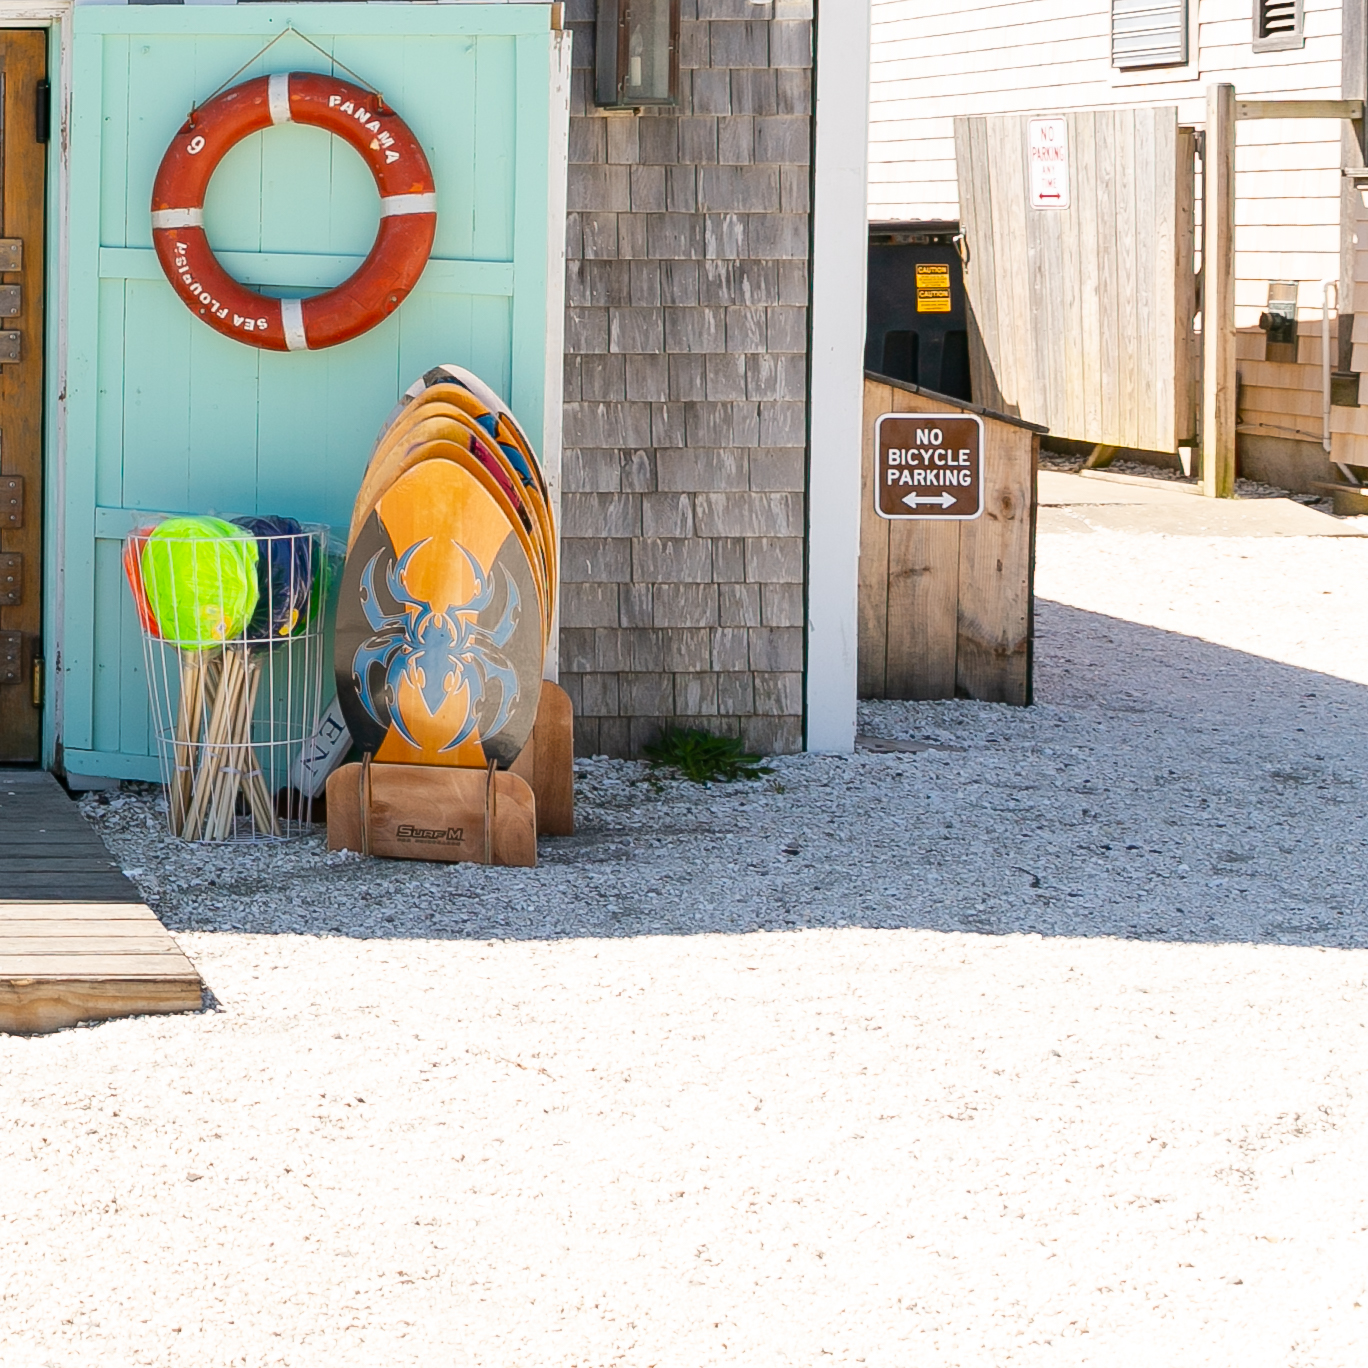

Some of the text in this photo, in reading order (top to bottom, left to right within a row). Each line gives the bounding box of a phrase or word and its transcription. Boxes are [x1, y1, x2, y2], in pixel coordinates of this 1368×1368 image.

[328, 94, 400, 164] PANAMA
[1040, 126, 1054, 141] NO
[1032, 145, 1064, 161] PARKING
[174, 241, 268, 332] SEA FLOURISH
[916, 428, 943, 446] NO
[888, 448, 970, 466] BICYCLE
[887, 468, 971, 487] PARKING
